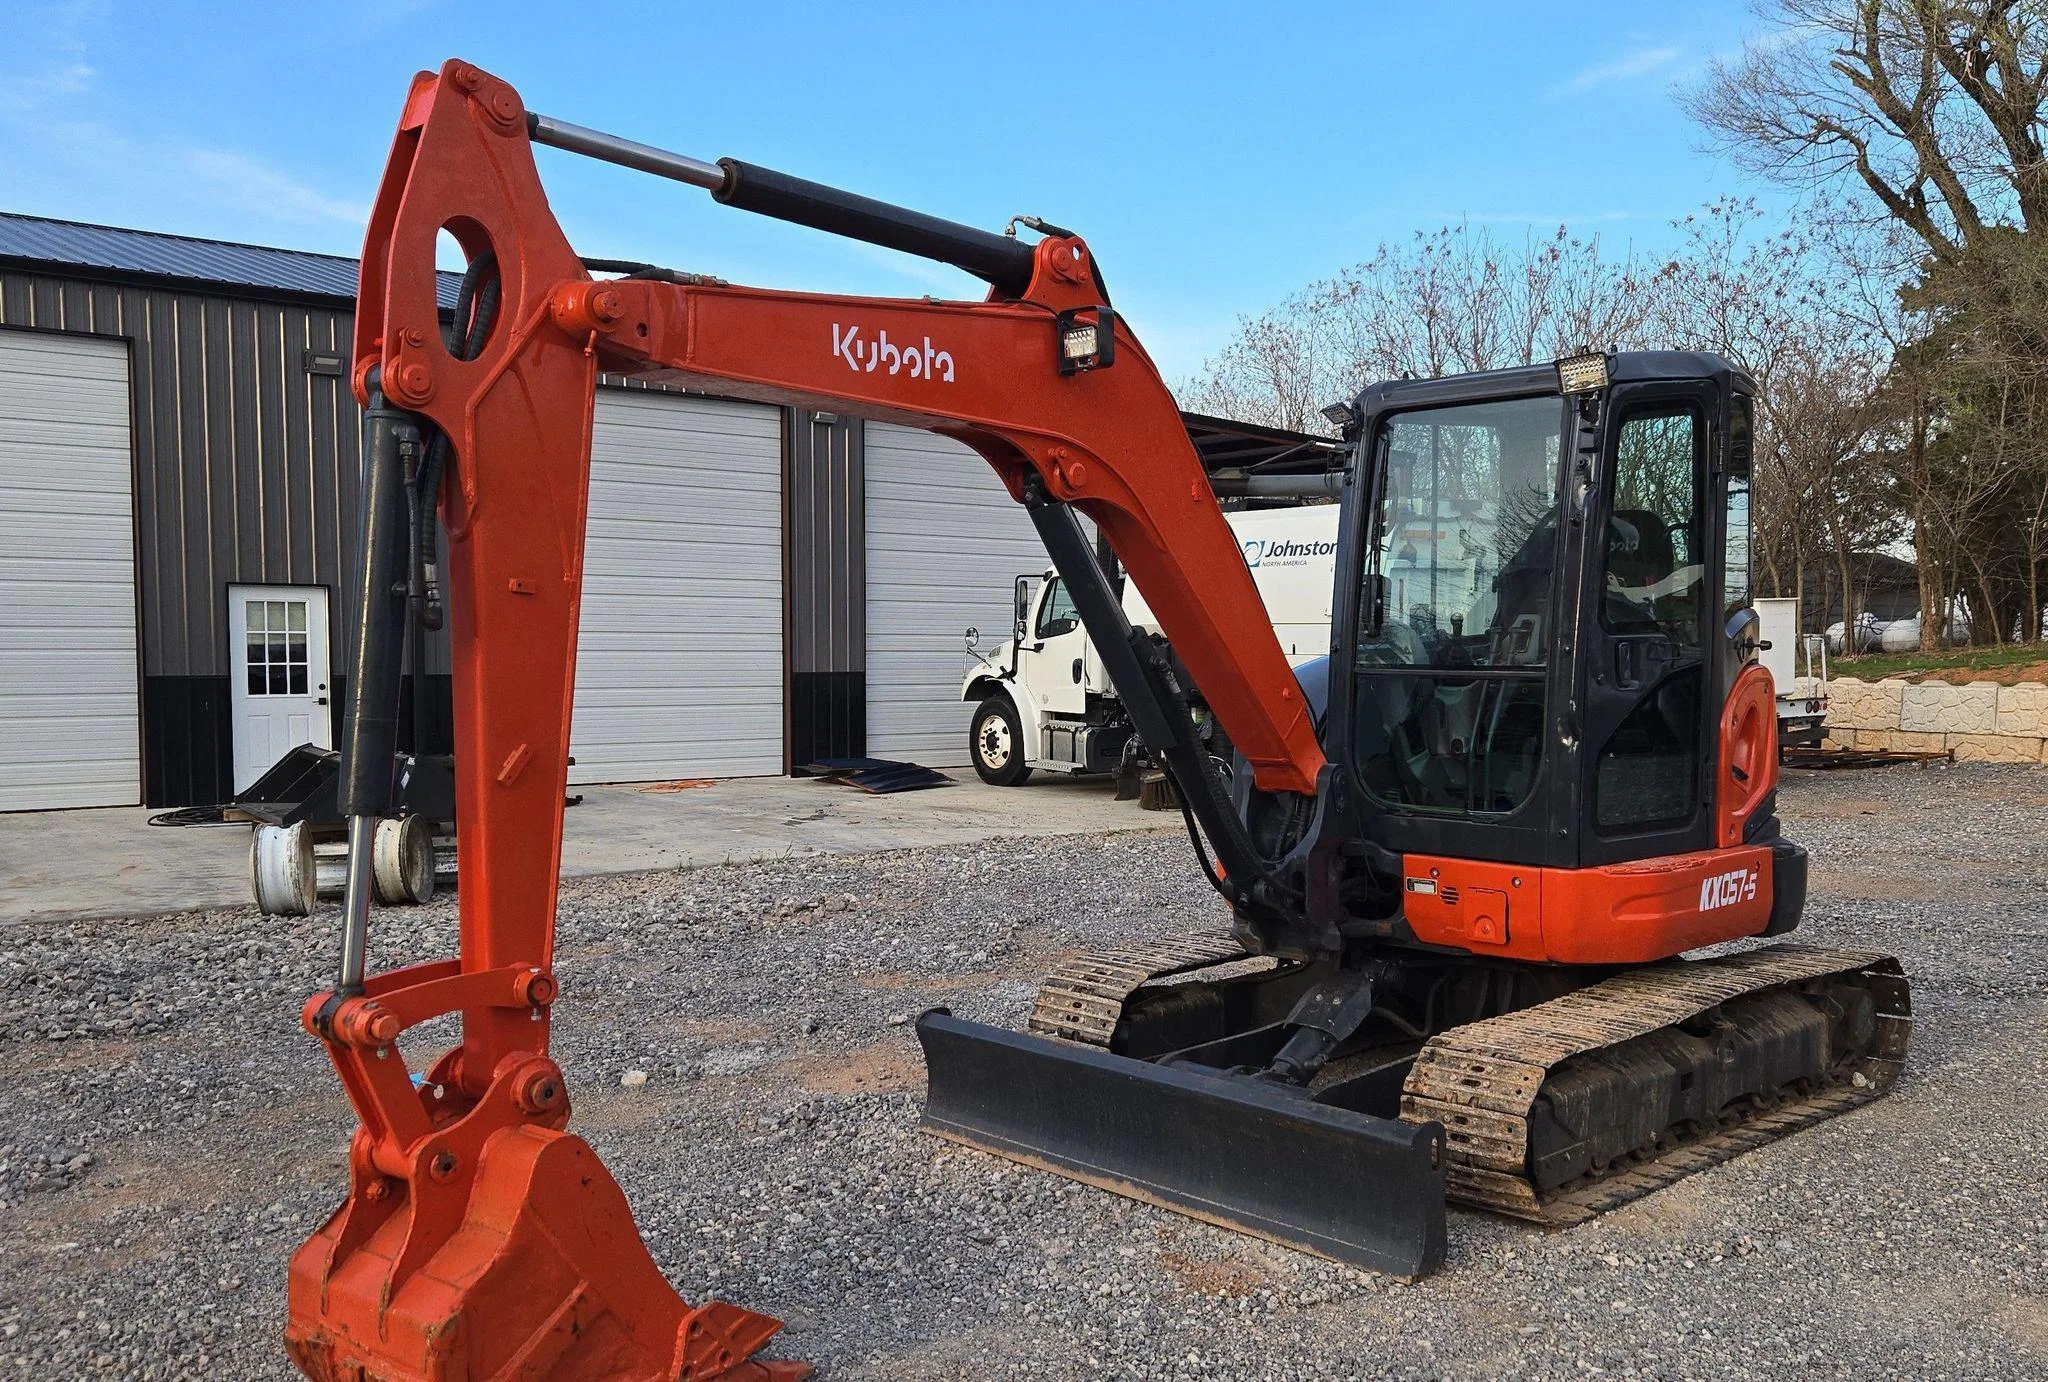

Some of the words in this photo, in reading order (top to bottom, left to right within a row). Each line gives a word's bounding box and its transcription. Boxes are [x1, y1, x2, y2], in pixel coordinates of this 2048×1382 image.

[832, 323, 955, 382] Kubota
[1282, 559, 1308, 567] AMERICA
[1699, 869, 1758, 912] KX057-5
